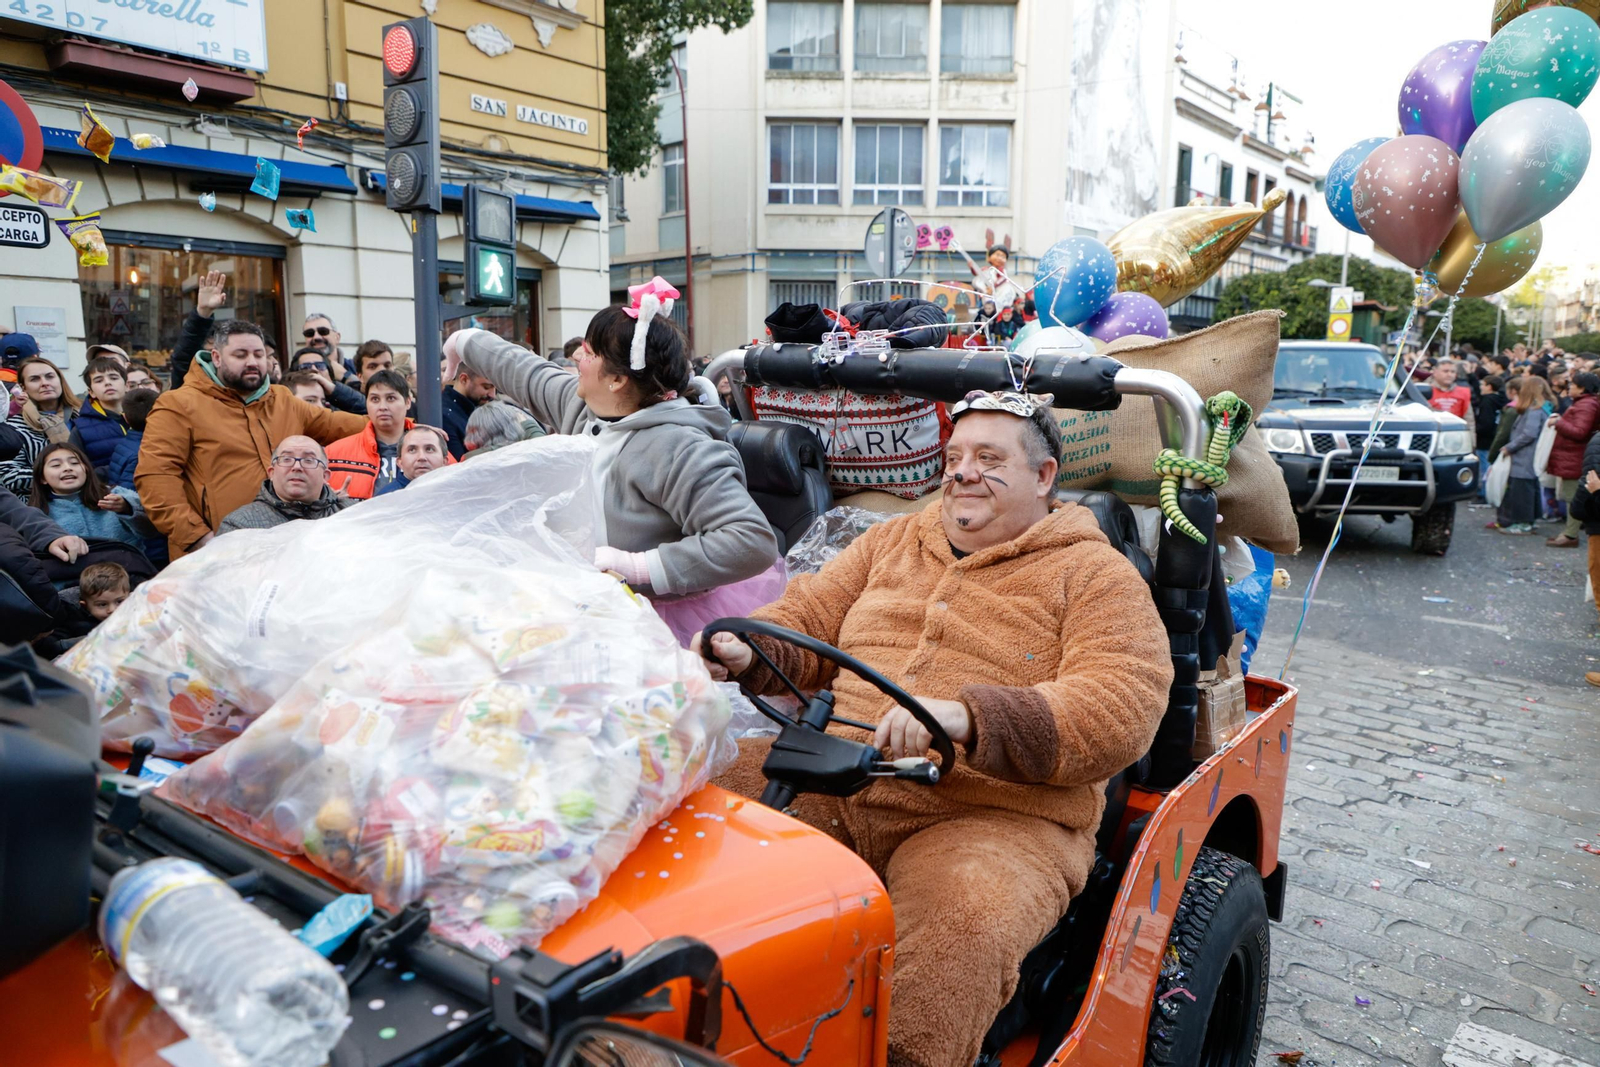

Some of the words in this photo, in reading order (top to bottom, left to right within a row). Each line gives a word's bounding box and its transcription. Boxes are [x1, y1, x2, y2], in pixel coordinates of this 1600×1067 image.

[97, 0, 216, 28] strella
[233, 48, 251, 63] B
[473, 96, 506, 115] SAN
[518, 107, 587, 133] JACINTO
[0, 209, 41, 225] CEPTO
